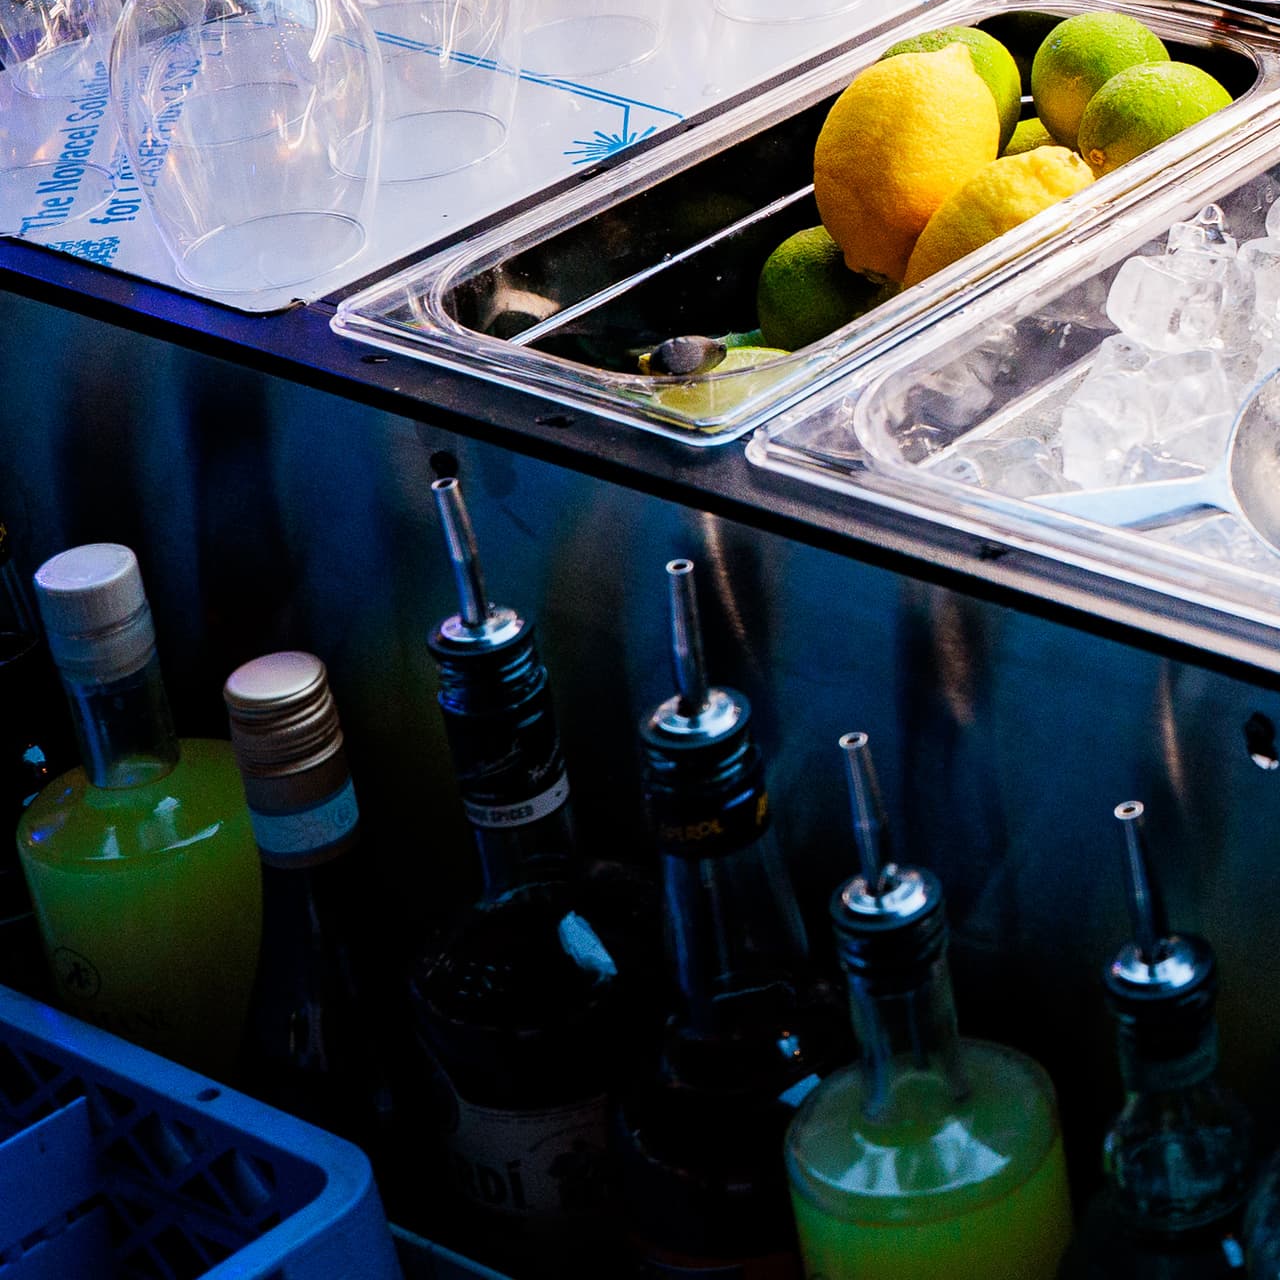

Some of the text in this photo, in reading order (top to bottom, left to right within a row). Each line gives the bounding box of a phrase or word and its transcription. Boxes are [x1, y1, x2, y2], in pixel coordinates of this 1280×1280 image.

[36, 123, 100, 194] Novacel
[20, 195, 74, 235] The
[89, 198, 142, 224] for
